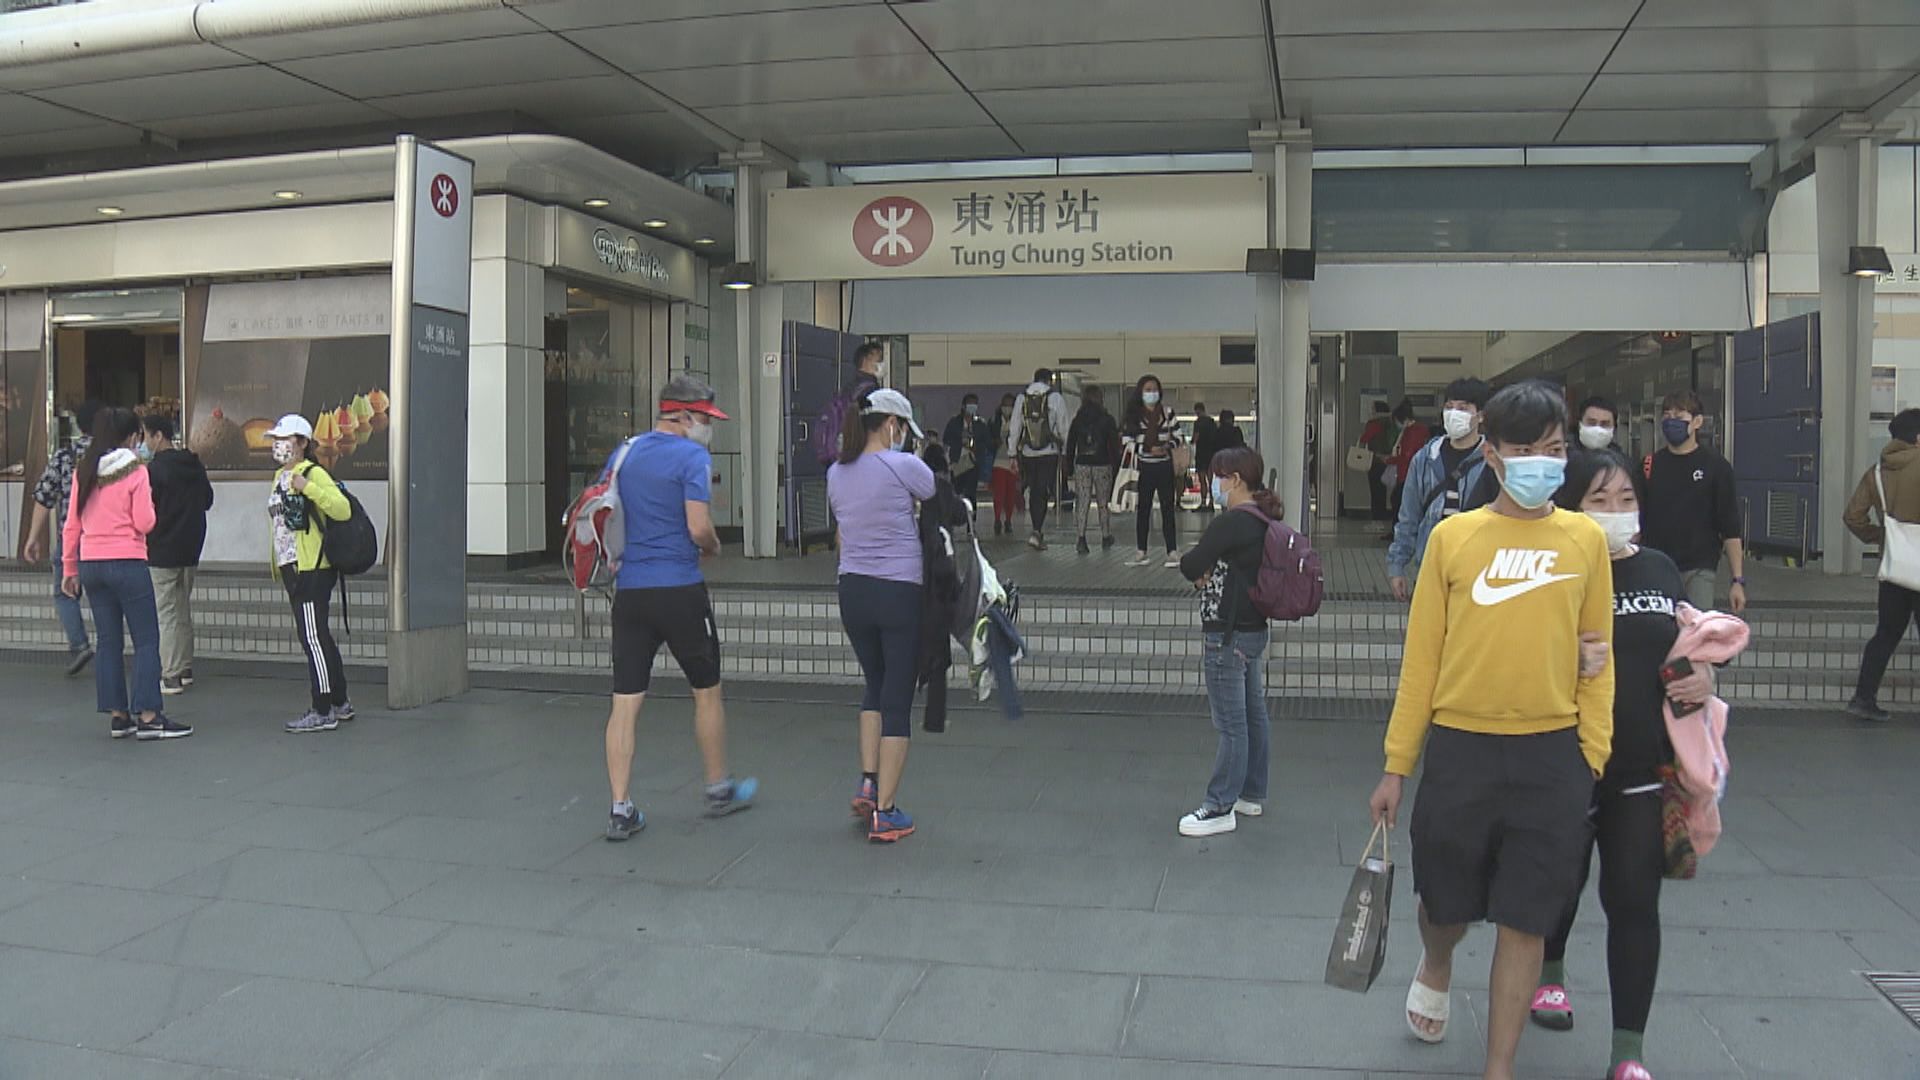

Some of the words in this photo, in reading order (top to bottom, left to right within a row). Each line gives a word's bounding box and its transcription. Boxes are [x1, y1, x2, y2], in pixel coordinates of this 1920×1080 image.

[952, 188, 1100, 236] 東涌站
[951, 245, 1006, 269] Tung
[1011, 242, 1085, 267] Chung
[1091, 239, 1174, 262] Station
[1487, 548, 1559, 580] NIKE
